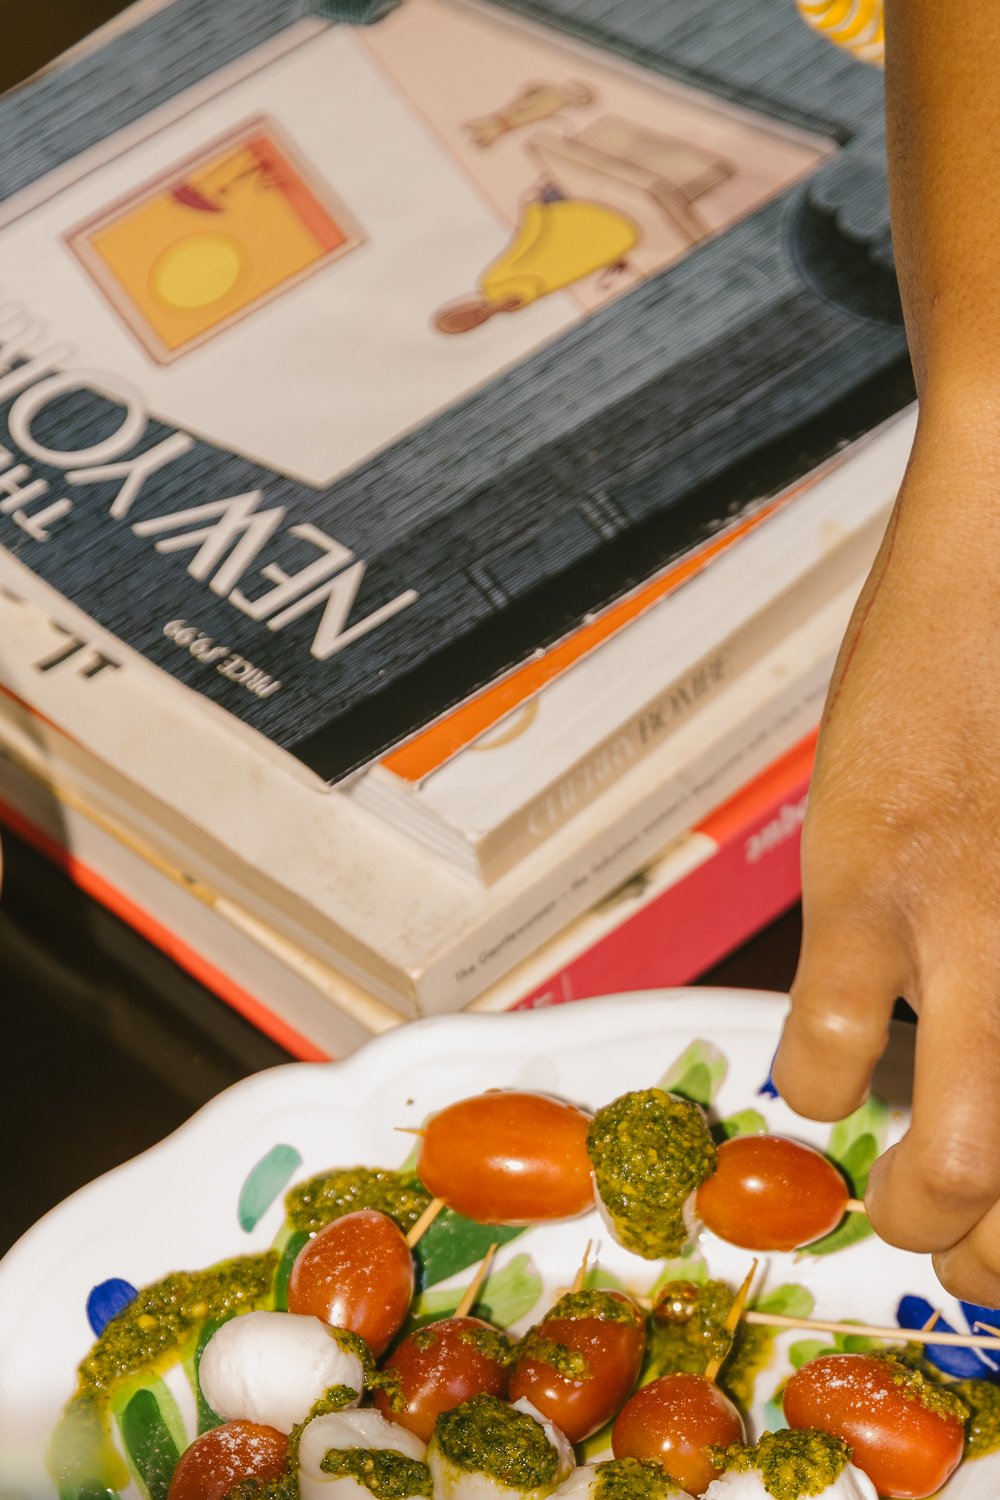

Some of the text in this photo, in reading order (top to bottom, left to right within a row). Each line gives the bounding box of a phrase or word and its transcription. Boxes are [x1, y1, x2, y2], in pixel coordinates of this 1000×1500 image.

[0, 446, 73, 543] TH
[131, 488, 421, 662] NEW
[216, 653, 284, 699] PRICE
